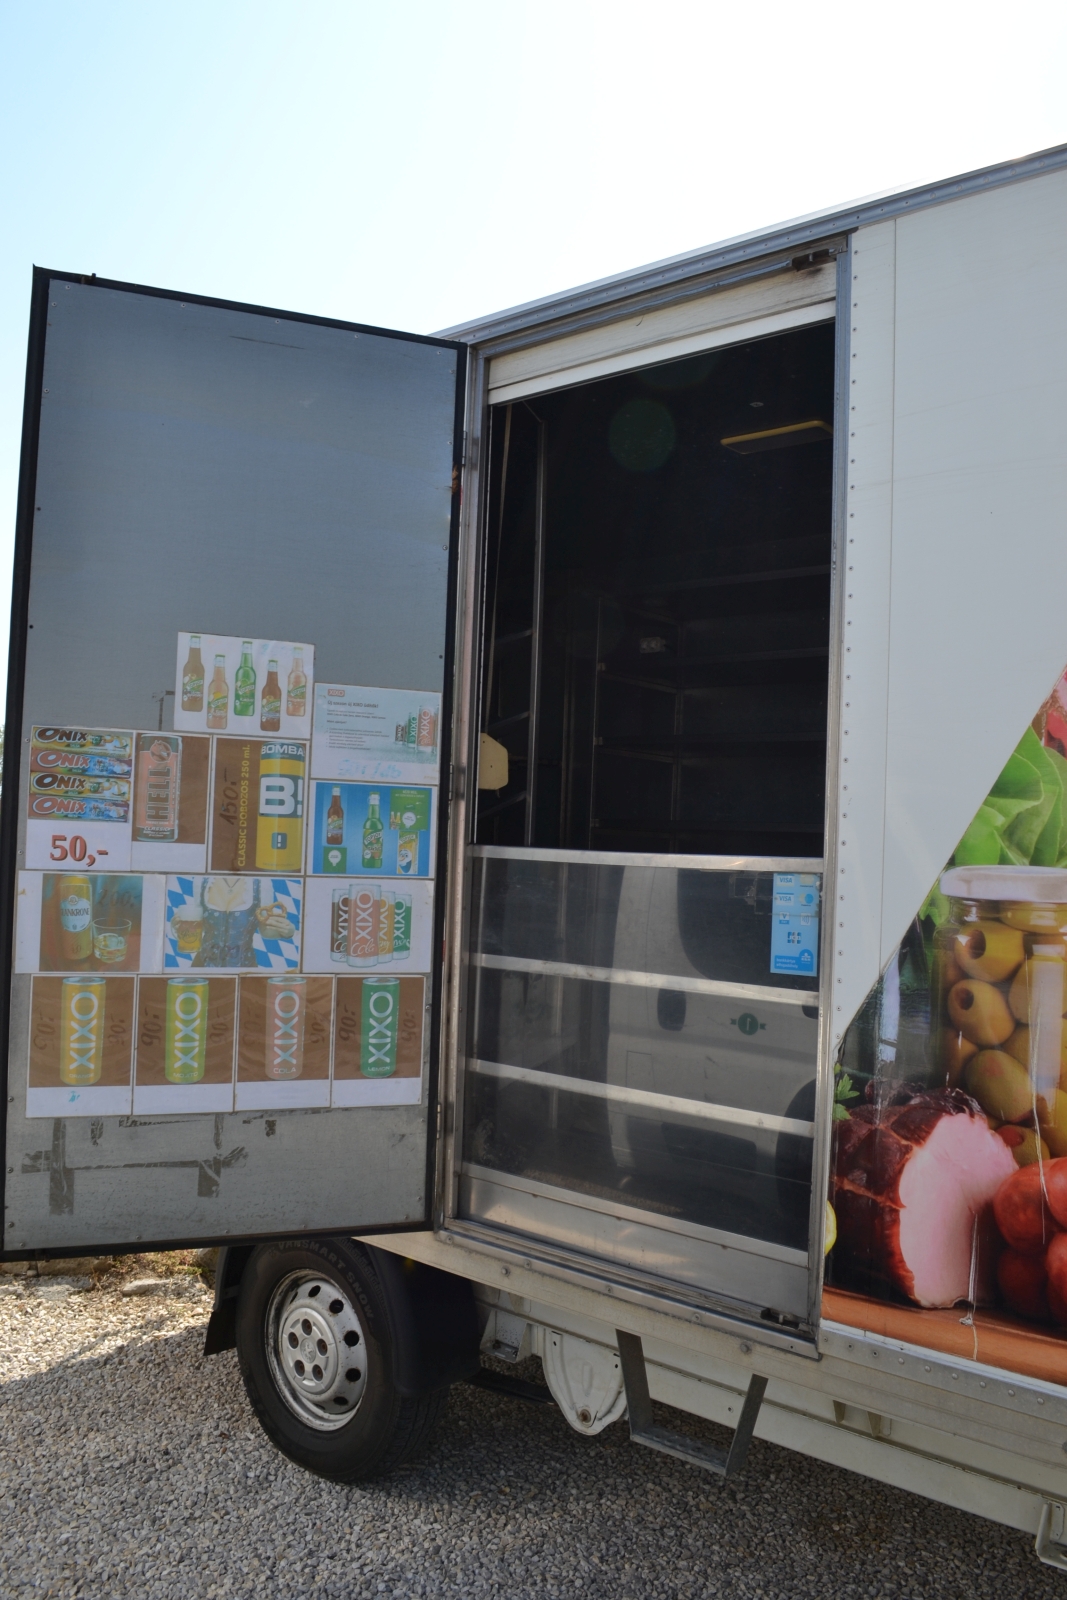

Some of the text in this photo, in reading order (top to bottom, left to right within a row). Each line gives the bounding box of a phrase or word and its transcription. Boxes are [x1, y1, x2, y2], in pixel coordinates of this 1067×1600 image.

[36, 727, 88, 743] ONIX
[409, 716, 417, 737] XIXO
[420, 709, 431, 737] XIXO
[37, 750, 90, 768] ONIX
[241, 760, 250, 778] 250
[261, 744, 305, 757] BOMBA
[33, 772, 87, 790] ONIX
[146, 766, 172, 821] HELL
[32, 796, 87, 814] ONIX
[239, 780, 249, 828] DOBOZOS
[50, 834, 109, 867] 50,-
[237, 829, 247, 867] CLASSIC
[355, 891, 373, 941] XIXO
[394, 900, 406, 939] XIXO
[69, 991, 99, 1070] XIXO
[174, 991, 202, 1069] XIXO
[273, 990, 300, 1065] XIXO
[368, 991, 394, 1064] XIXO
[347, 1271, 375, 1320] SNOW
